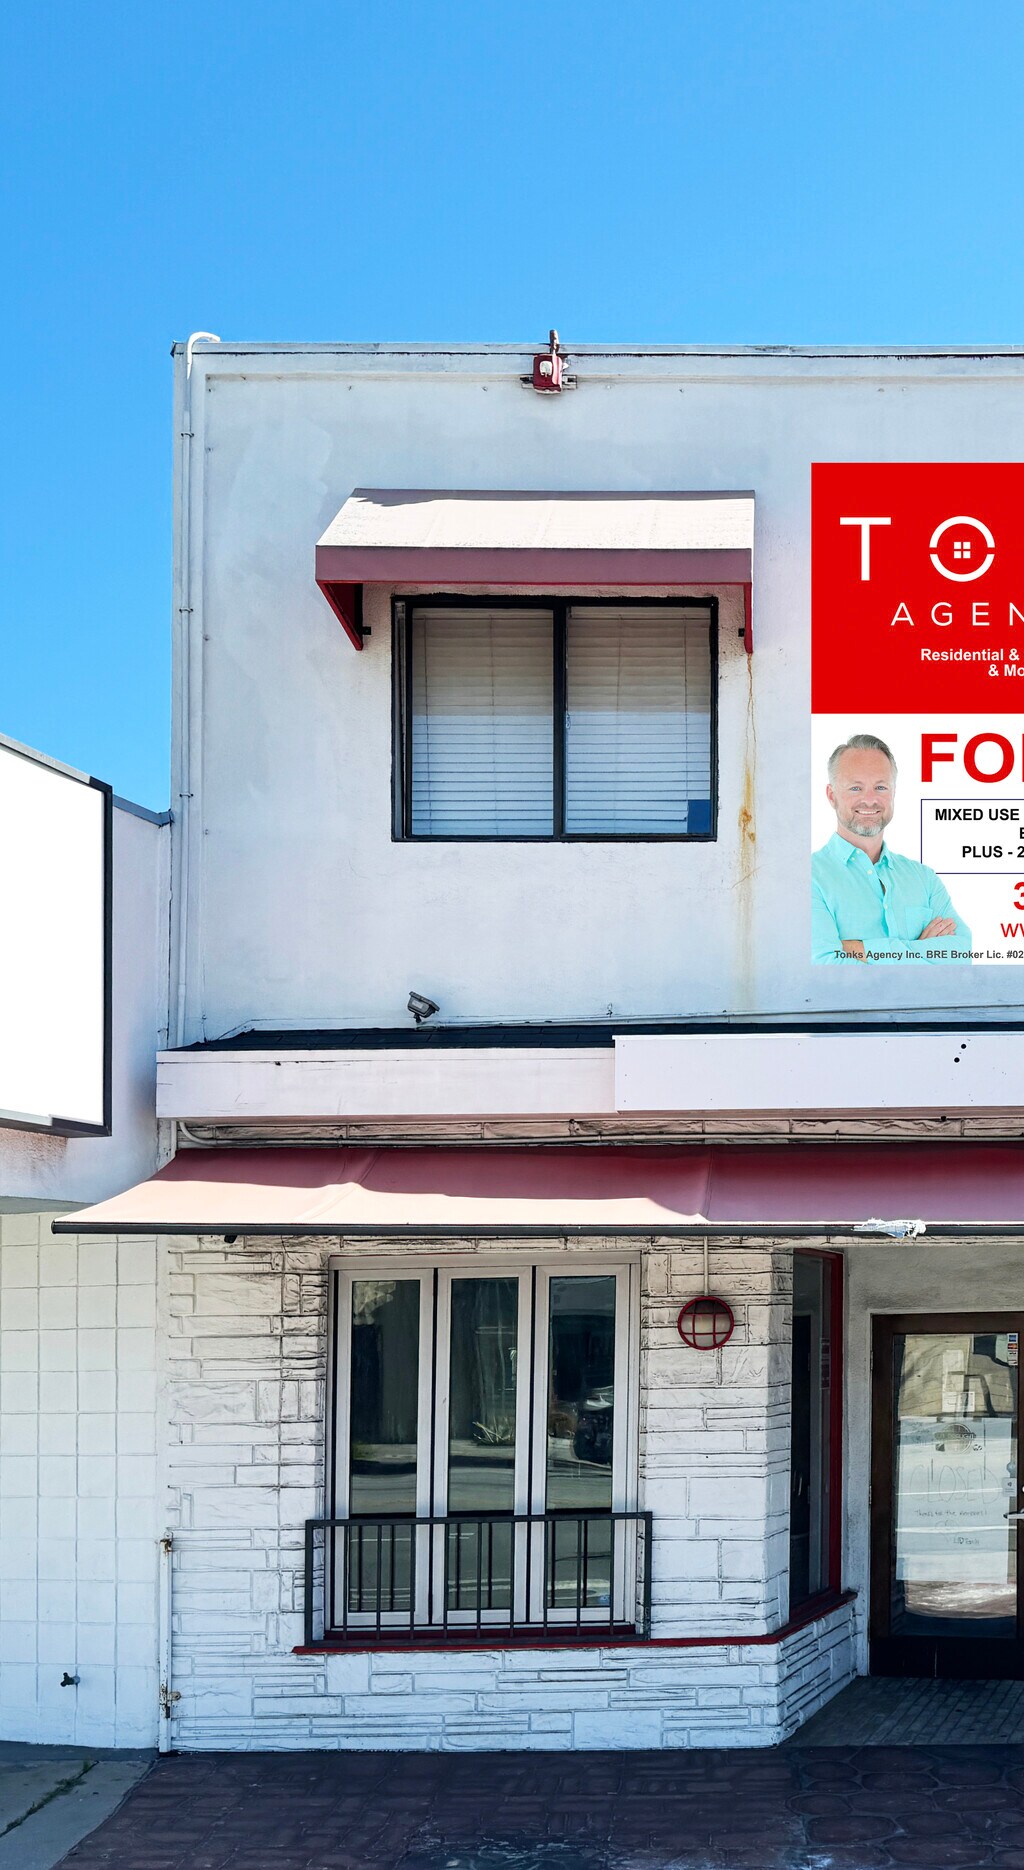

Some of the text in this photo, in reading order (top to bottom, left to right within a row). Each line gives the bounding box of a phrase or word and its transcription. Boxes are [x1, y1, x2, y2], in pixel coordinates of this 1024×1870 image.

[920, 648, 1004, 661] Residential
[1008, 648, 1020, 661] &
[987, 663, 1000, 677] &
[935, 808, 984, 821] MIXED
[988, 808, 1020, 821] USE
[962, 845, 1003, 859] PLUS
[834, 950, 864, 959] Tonks
[865, 950, 903, 961] Agency
[905, 950, 924, 959] Inc.
[926, 950, 948, 959] BRE
[950, 950, 984, 959] Broker
[986, 950, 1005, 959] Lic.
